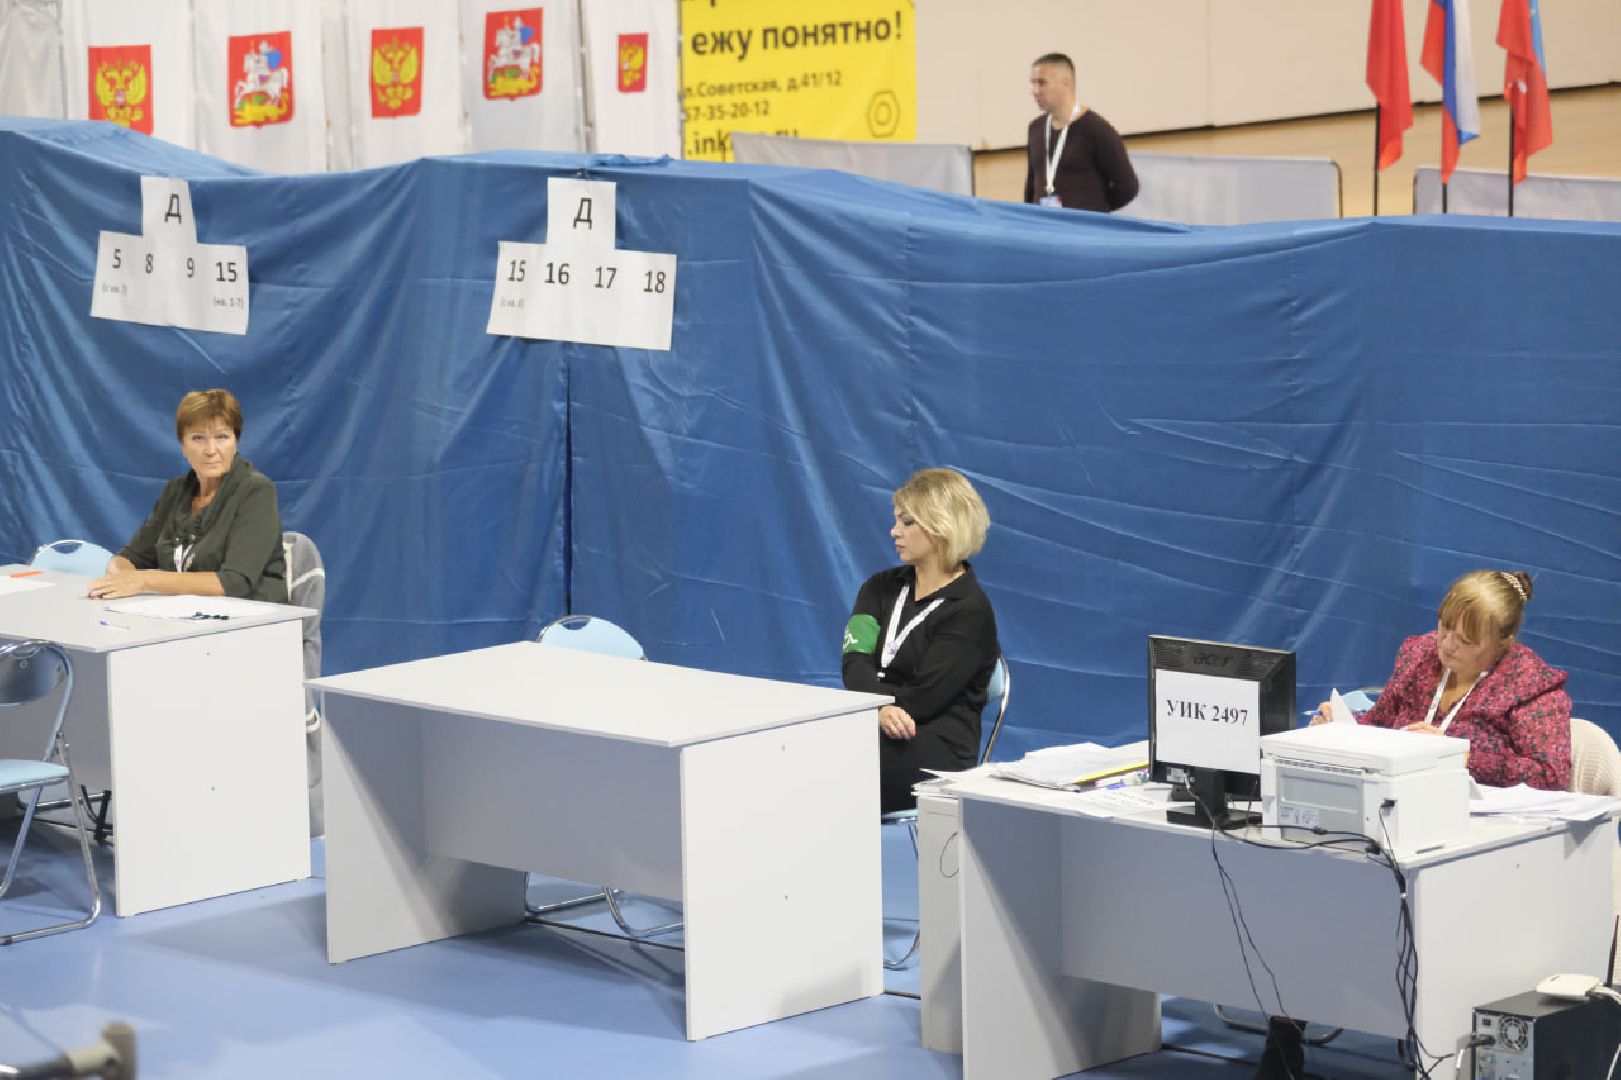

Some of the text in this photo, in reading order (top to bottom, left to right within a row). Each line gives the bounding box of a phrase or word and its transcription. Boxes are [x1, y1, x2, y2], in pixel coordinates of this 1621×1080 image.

[692, 11, 902, 62] ежу понятно!
[164, 193, 183, 225] Д
[573, 197, 593, 230] Д
[112, 248, 238, 283] 5 8 9 15
[507, 259, 667, 294] 15 16 17 18
[1167, 699, 1248, 725] УИК 2497
